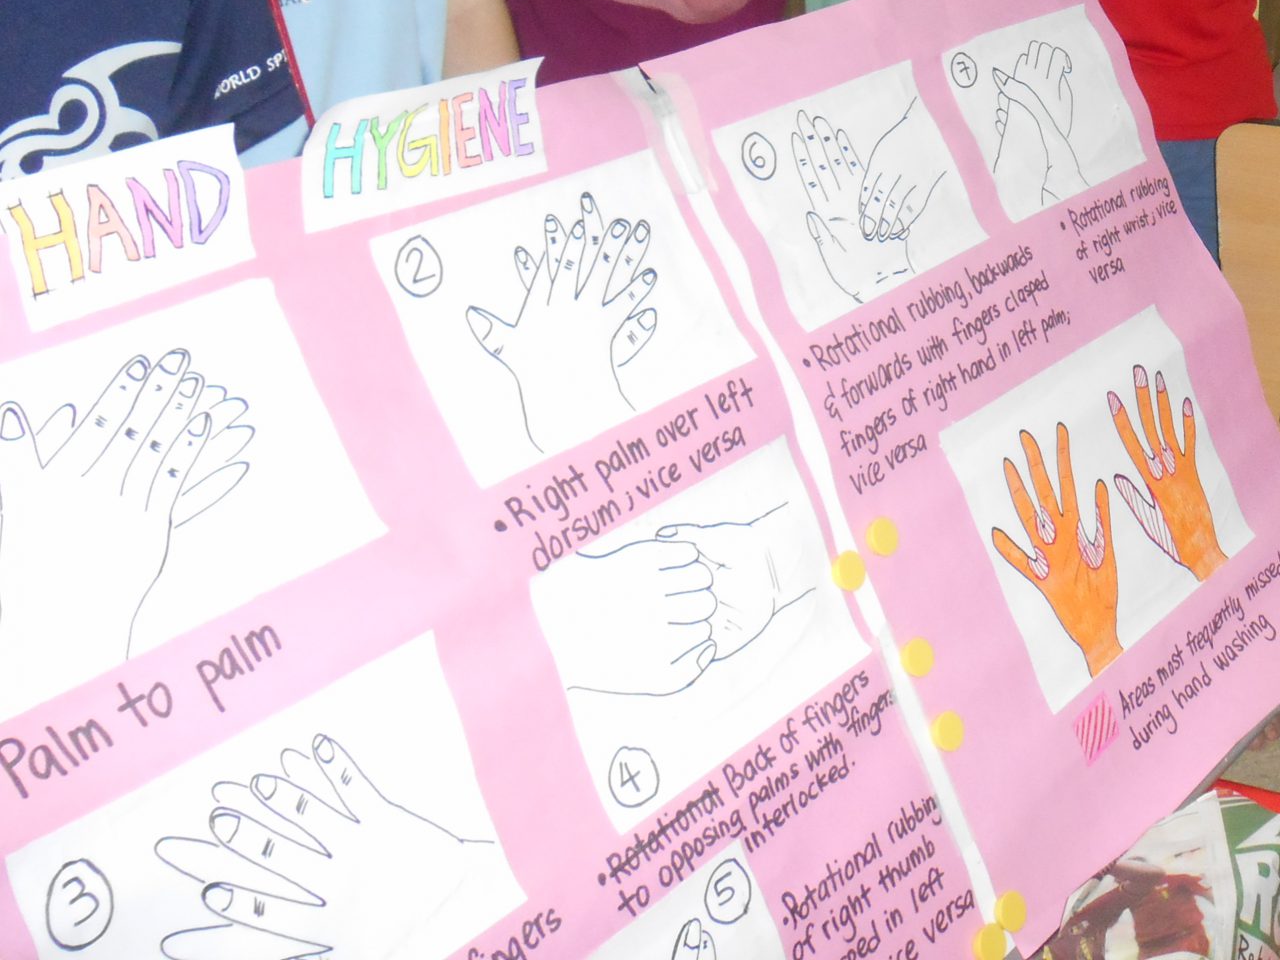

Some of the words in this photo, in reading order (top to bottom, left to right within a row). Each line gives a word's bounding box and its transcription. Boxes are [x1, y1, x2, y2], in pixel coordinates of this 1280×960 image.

[7, 160, 231, 300] HAND
[322, 77, 536, 198] HYGIENE
[1067, 189, 1128, 237] Rotational
[1129, 177, 1172, 203] rubbing
[1076, 240, 1090, 261] of
[1092, 225, 1122, 257] right
[1155, 199, 1179, 220] vice
[809, 307, 907, 372] Rotational
[964, 245, 1034, 295] backwards
[1088, 257, 1127, 285] versa
[839, 407, 897, 457] fingers
[901, 388, 919, 417] of
[922, 371, 958, 412] right
[957, 347, 998, 385] hand
[998, 339, 1013, 364] in
[1011, 320, 1038, 354] left
[840, 352, 913, 409] forwards
[916, 335, 949, 367] with
[951, 303, 1002, 346] fingers
[1004, 270, 1050, 312] clasped
[503, 464, 590, 528] Right
[594, 437, 651, 494] palm
[655, 407, 700, 448] over
[704, 377, 755, 420] left
[689, 425, 748, 474] versa
[848, 460, 887, 496] vice
[885, 433, 929, 471] versa
[0, 718, 115, 800] Palm
[116, 681, 174, 728] to
[195, 624, 283, 714] palm
[1118, 676, 1157, 721] Areas
[1156, 643, 1185, 687] most
[1185, 595, 1246, 658] frequently
[1129, 702, 1178, 751] during
[1171, 660, 1213, 711] hand
[1213, 613, 1278, 673] washing
[722, 743, 778, 799] Back
[778, 717, 802, 754] of
[801, 669, 870, 733] fingers
[616, 885, 651, 917] to
[657, 809, 748, 888] opposing
[748, 762, 801, 825] palms
[804, 730, 844, 772] with
[781, 832, 883, 931] Rotational
[792, 922, 816, 960] of
[821, 883, 872, 944] right
[878, 835, 936, 893] thumb
[884, 908, 904, 933] in
[910, 867, 945, 913] left
[922, 889, 975, 944] versa
